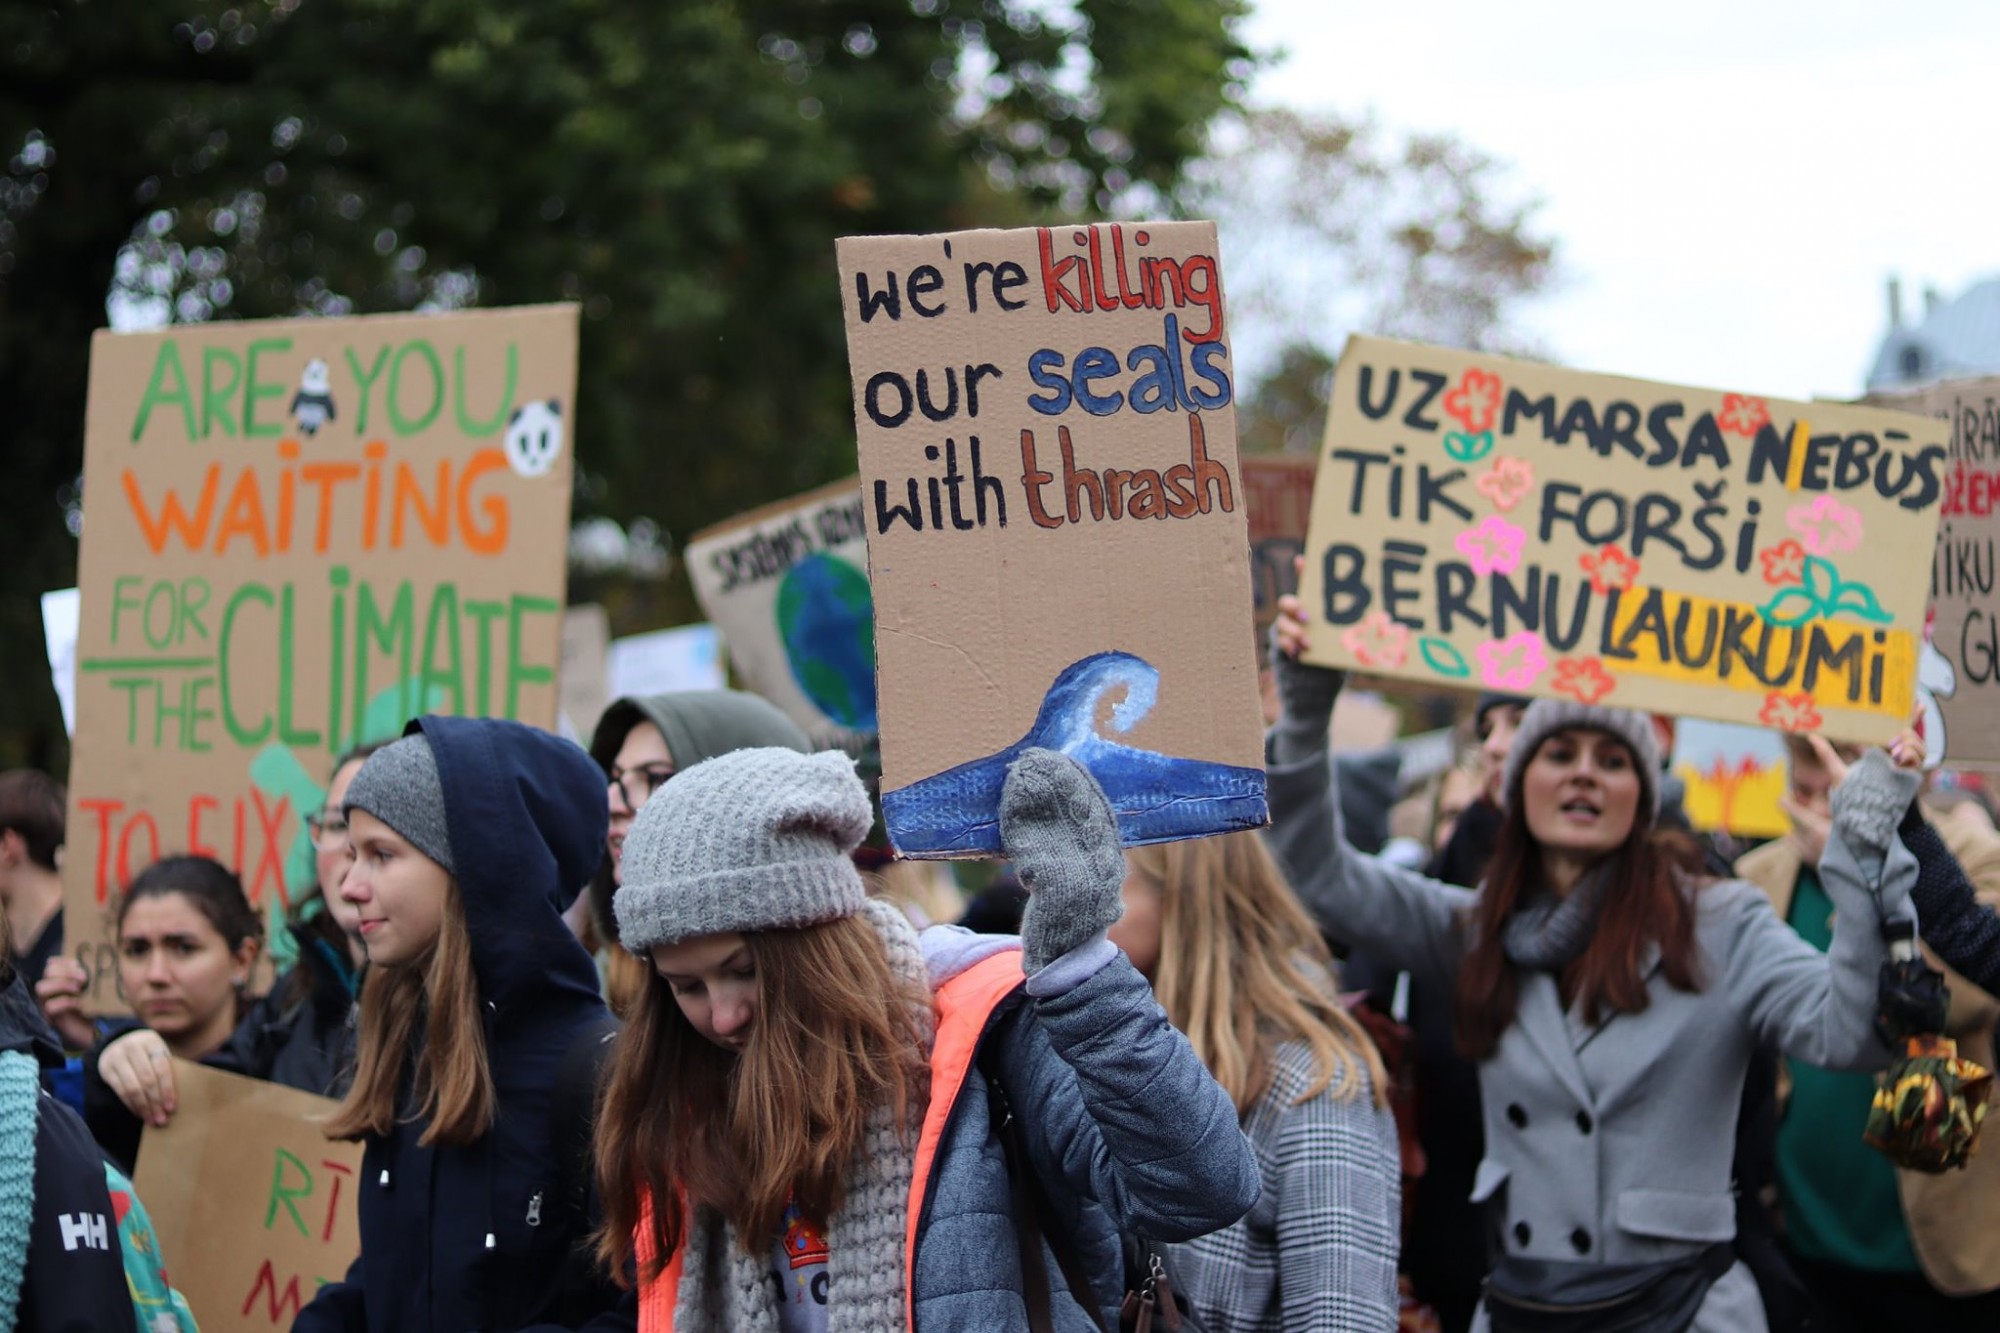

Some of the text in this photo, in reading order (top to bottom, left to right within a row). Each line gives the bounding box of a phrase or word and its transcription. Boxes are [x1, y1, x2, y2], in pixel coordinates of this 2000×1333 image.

[855, 223, 1224, 344] we're killing
[131, 338, 519, 444] ARE YOU
[864, 313, 1231, 428] our seals
[1356, 365, 1449, 430] UZ
[1502, 388, 1730, 469] MARSA
[874, 435, 1008, 535] with
[1020, 412, 1234, 530] thrash
[111, 576, 212, 651] FOR
[1323, 541, 1592, 653] BĒRNU
[108, 676, 216, 752] THE
[78, 786, 291, 910] TO FIX
[58, 1212, 109, 1251] HH
